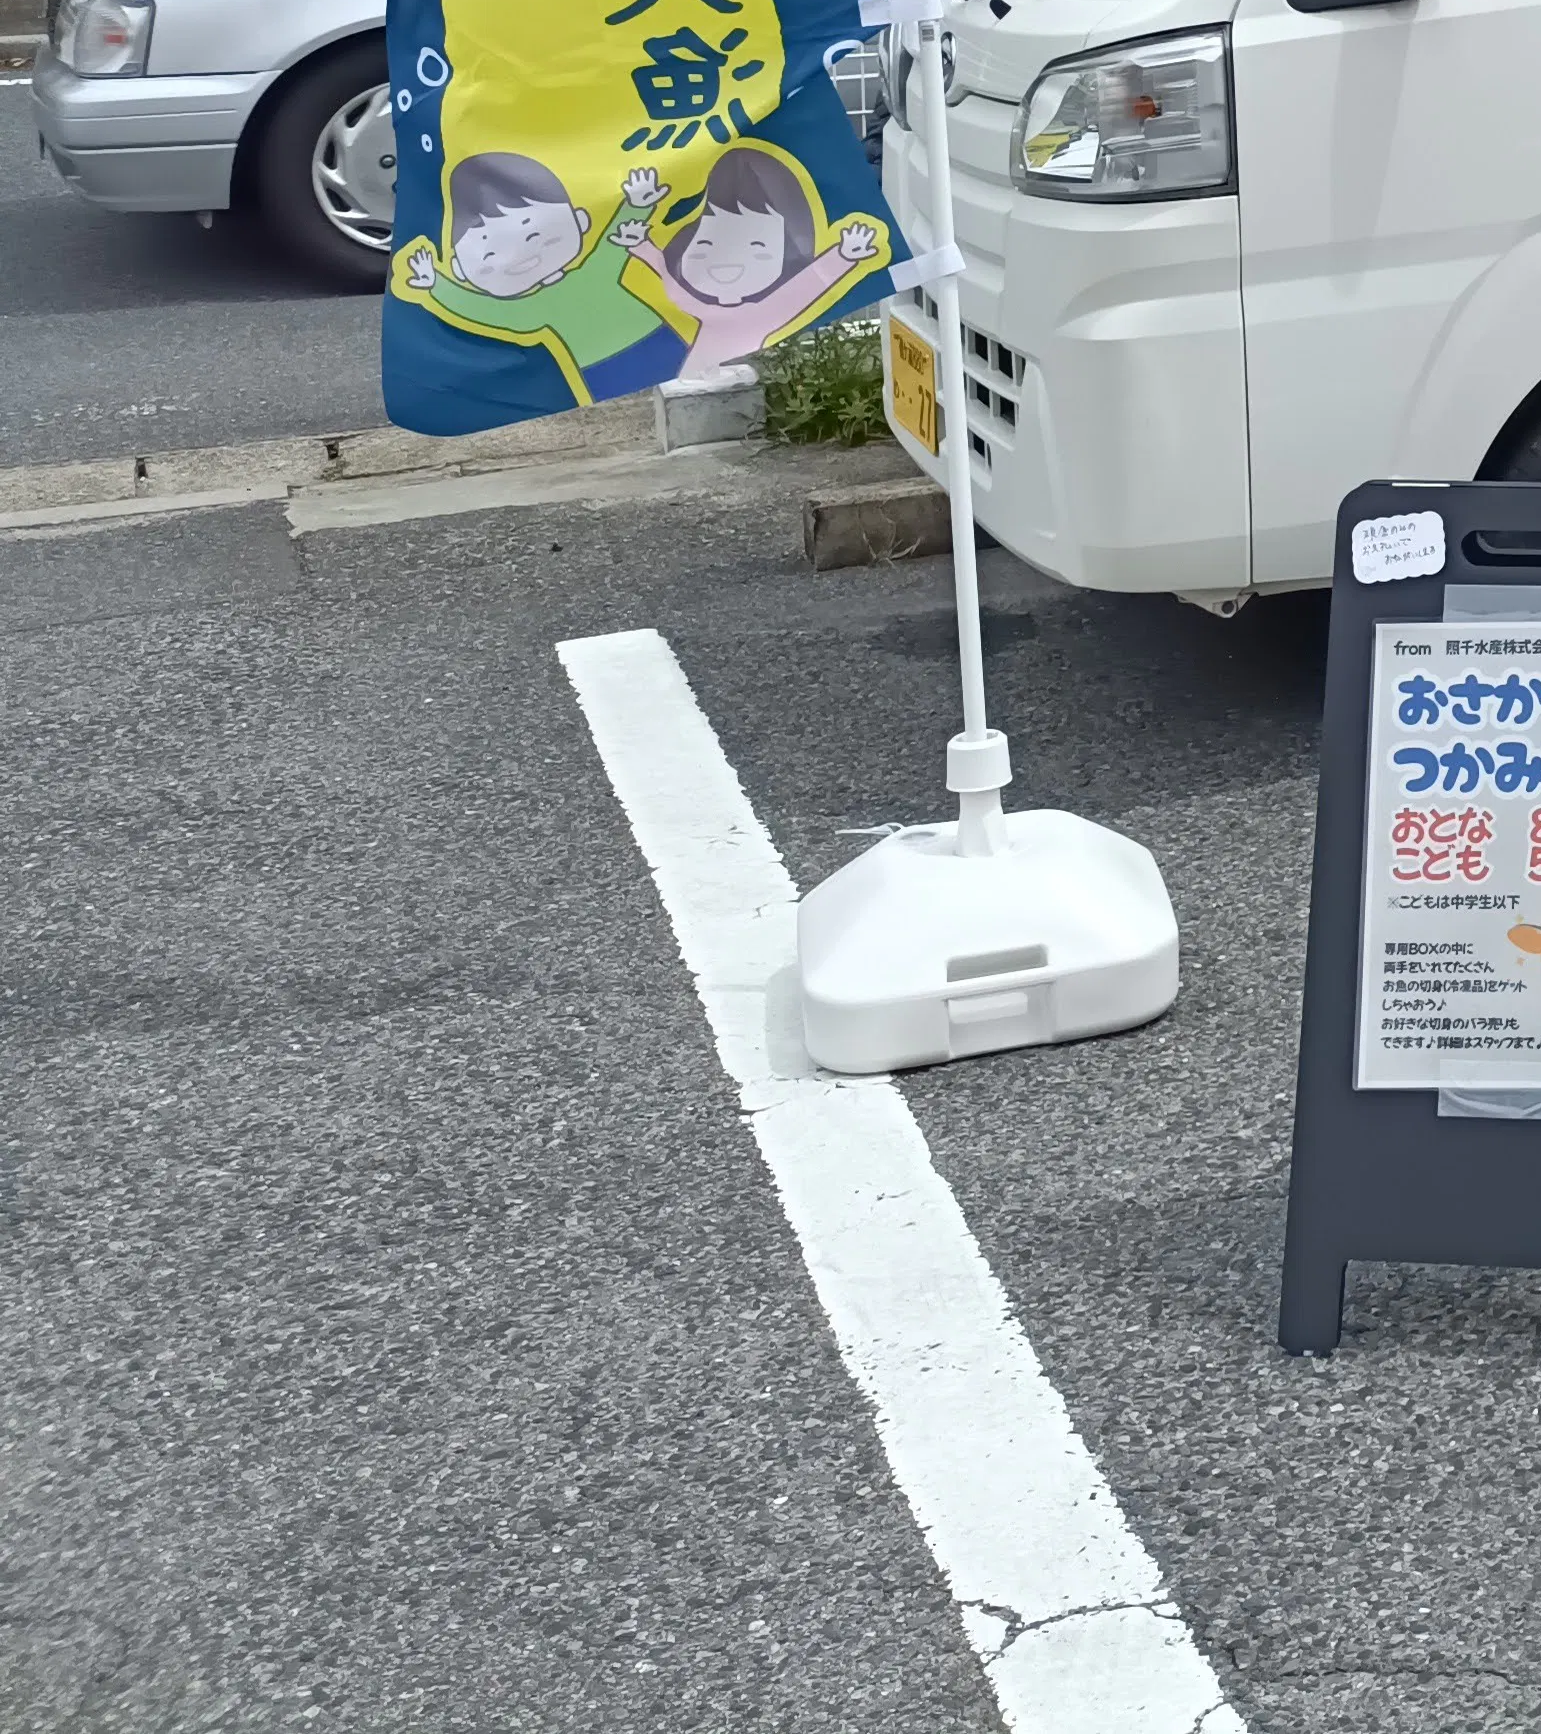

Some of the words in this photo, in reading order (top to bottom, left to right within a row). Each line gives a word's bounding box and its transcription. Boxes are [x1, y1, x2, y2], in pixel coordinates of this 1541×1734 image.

[1394, 640, 1432, 656] from
[1391, 806, 1494, 844] おとな
[1392, 843, 1490, 881] こども
[1387, 894, 1521, 910] ※こどもは中学生以下
[1384, 941, 1474, 956] 専用BOXの中に
[1383, 960, 1495, 974] 両手をいれてたくさん
[1380, 1017, 1521, 1030] お好きな切身のバラ売りも
